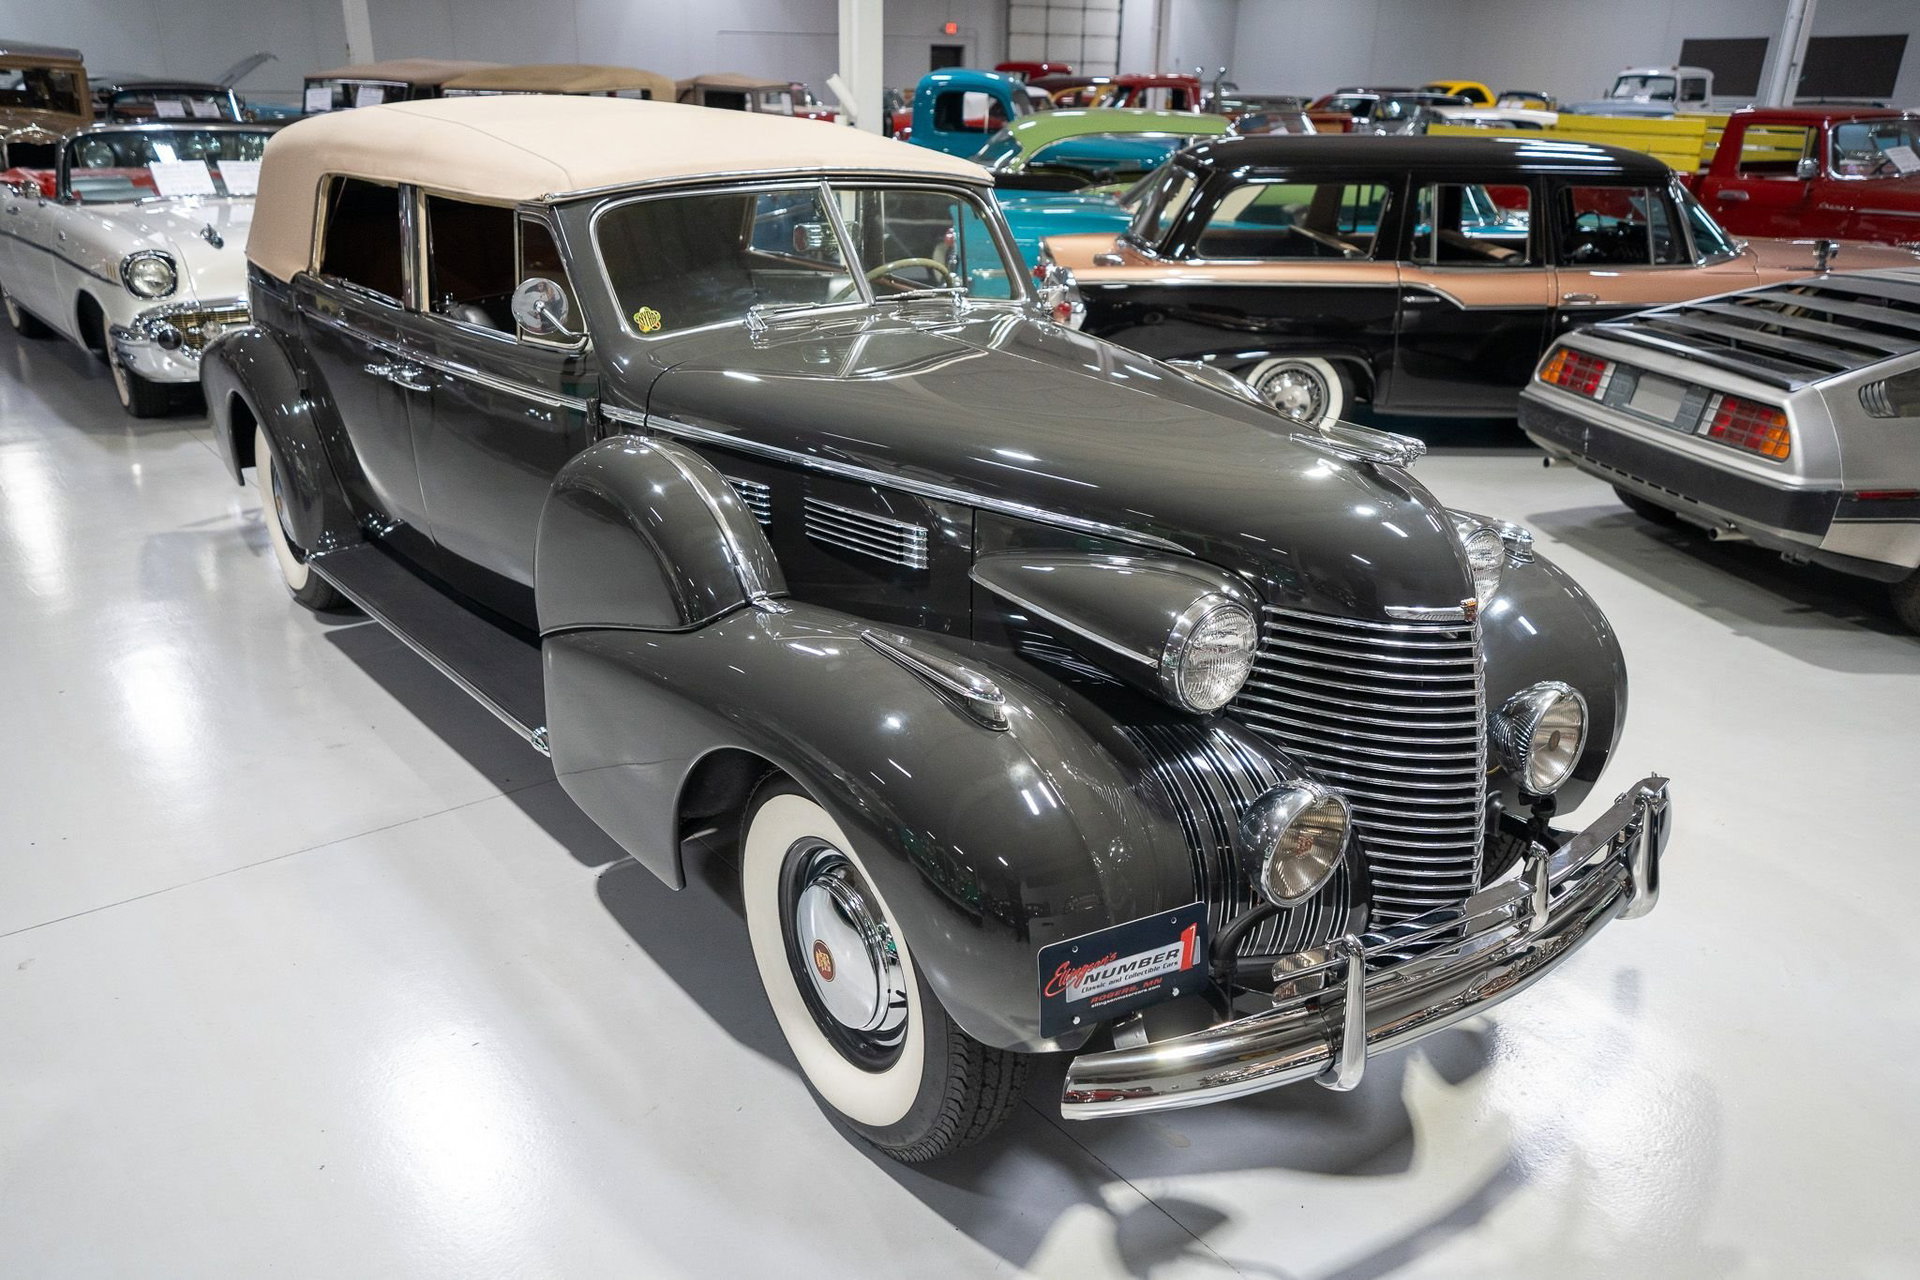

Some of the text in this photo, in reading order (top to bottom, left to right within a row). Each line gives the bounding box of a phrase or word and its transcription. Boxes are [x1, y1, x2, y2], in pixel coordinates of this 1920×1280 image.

[1083, 922, 1197, 985] NUMBER 1
[1081, 961, 1178, 993] Classic and Collectible Cars
[1142, 977, 1163, 988] MN
